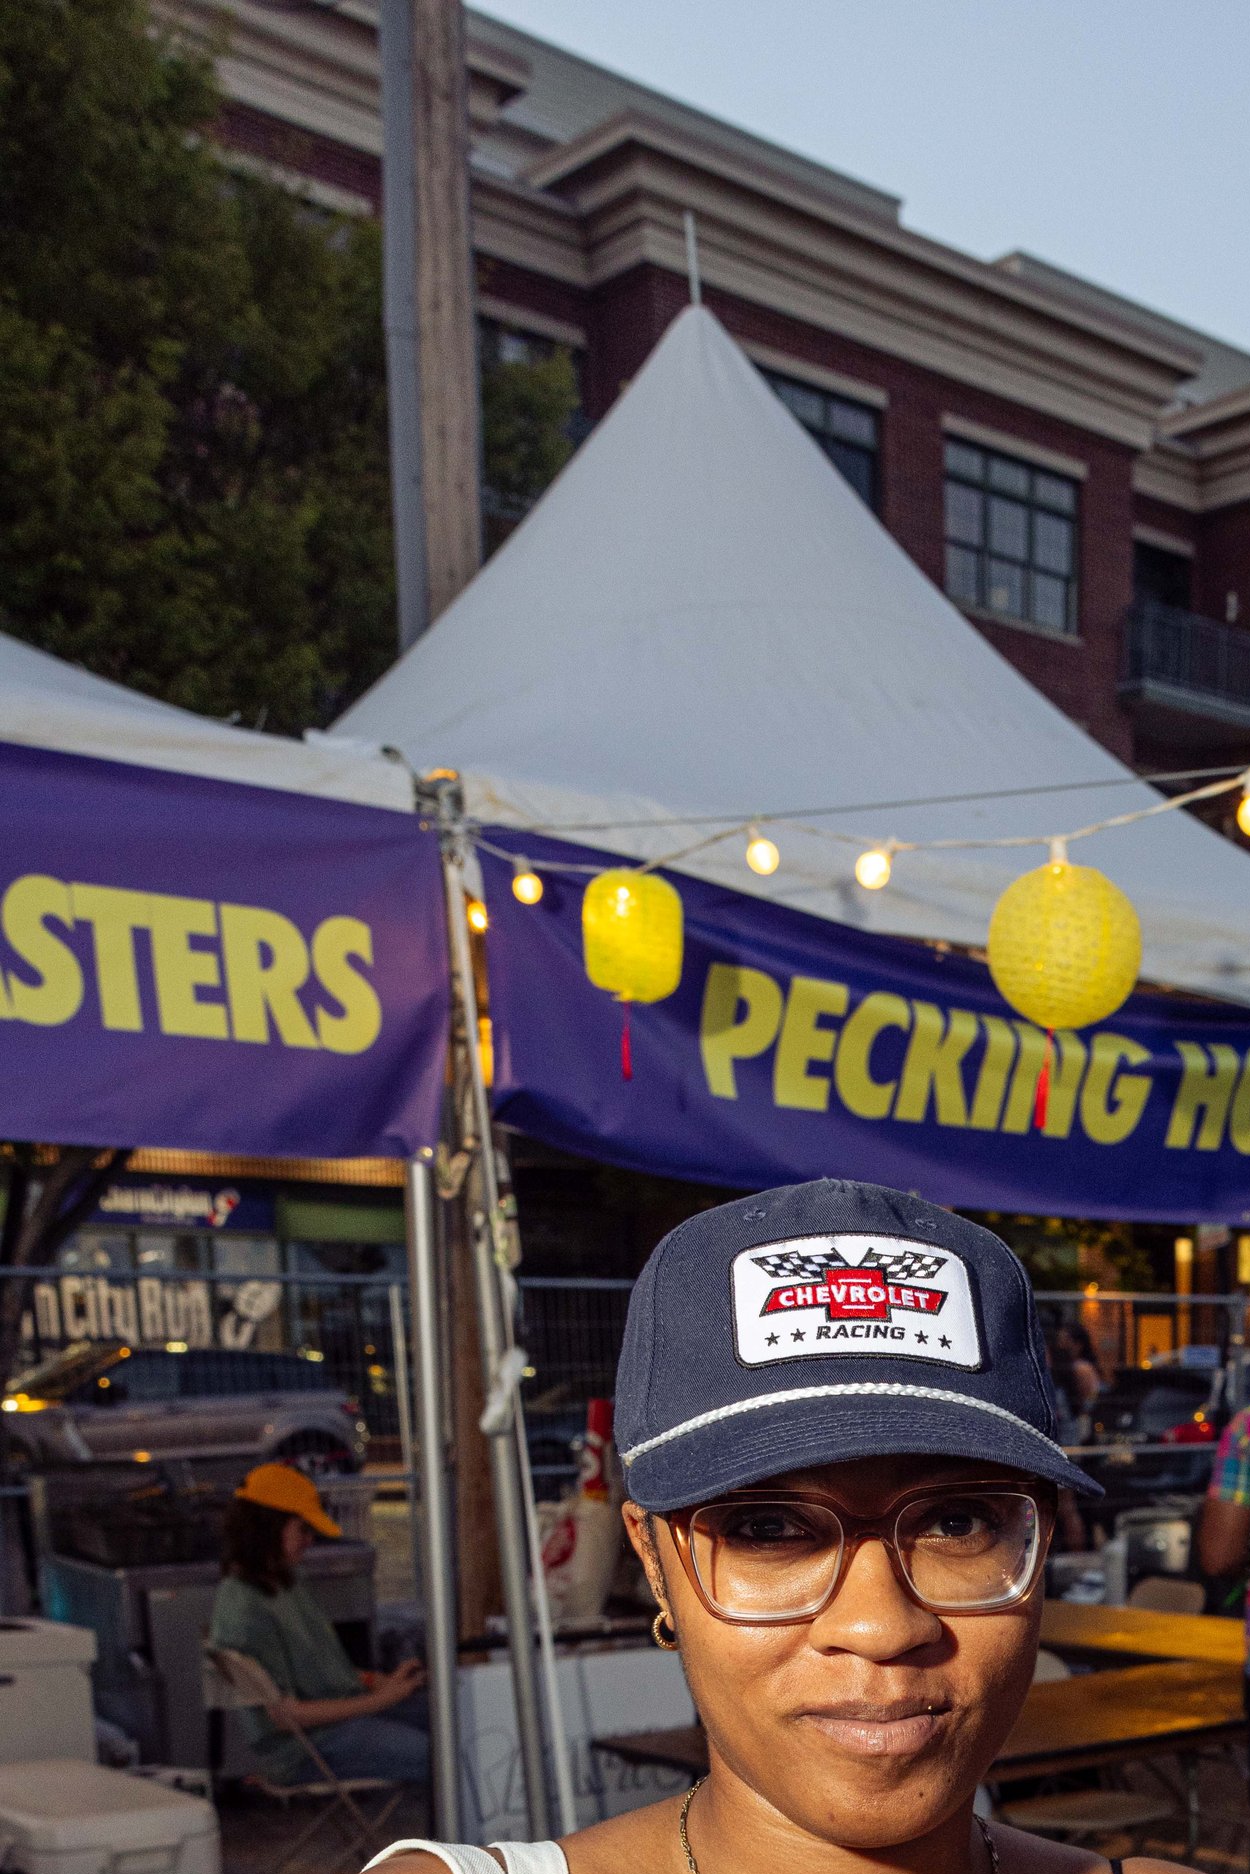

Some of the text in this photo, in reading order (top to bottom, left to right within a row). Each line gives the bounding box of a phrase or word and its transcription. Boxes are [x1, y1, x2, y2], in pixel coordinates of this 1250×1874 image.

[0, 873, 383, 1056] STERS
[701, 961, 1154, 1146] PECKING
[778, 1284, 930, 1309] CHEVROLET
[815, 1324, 906, 1341] RACING
